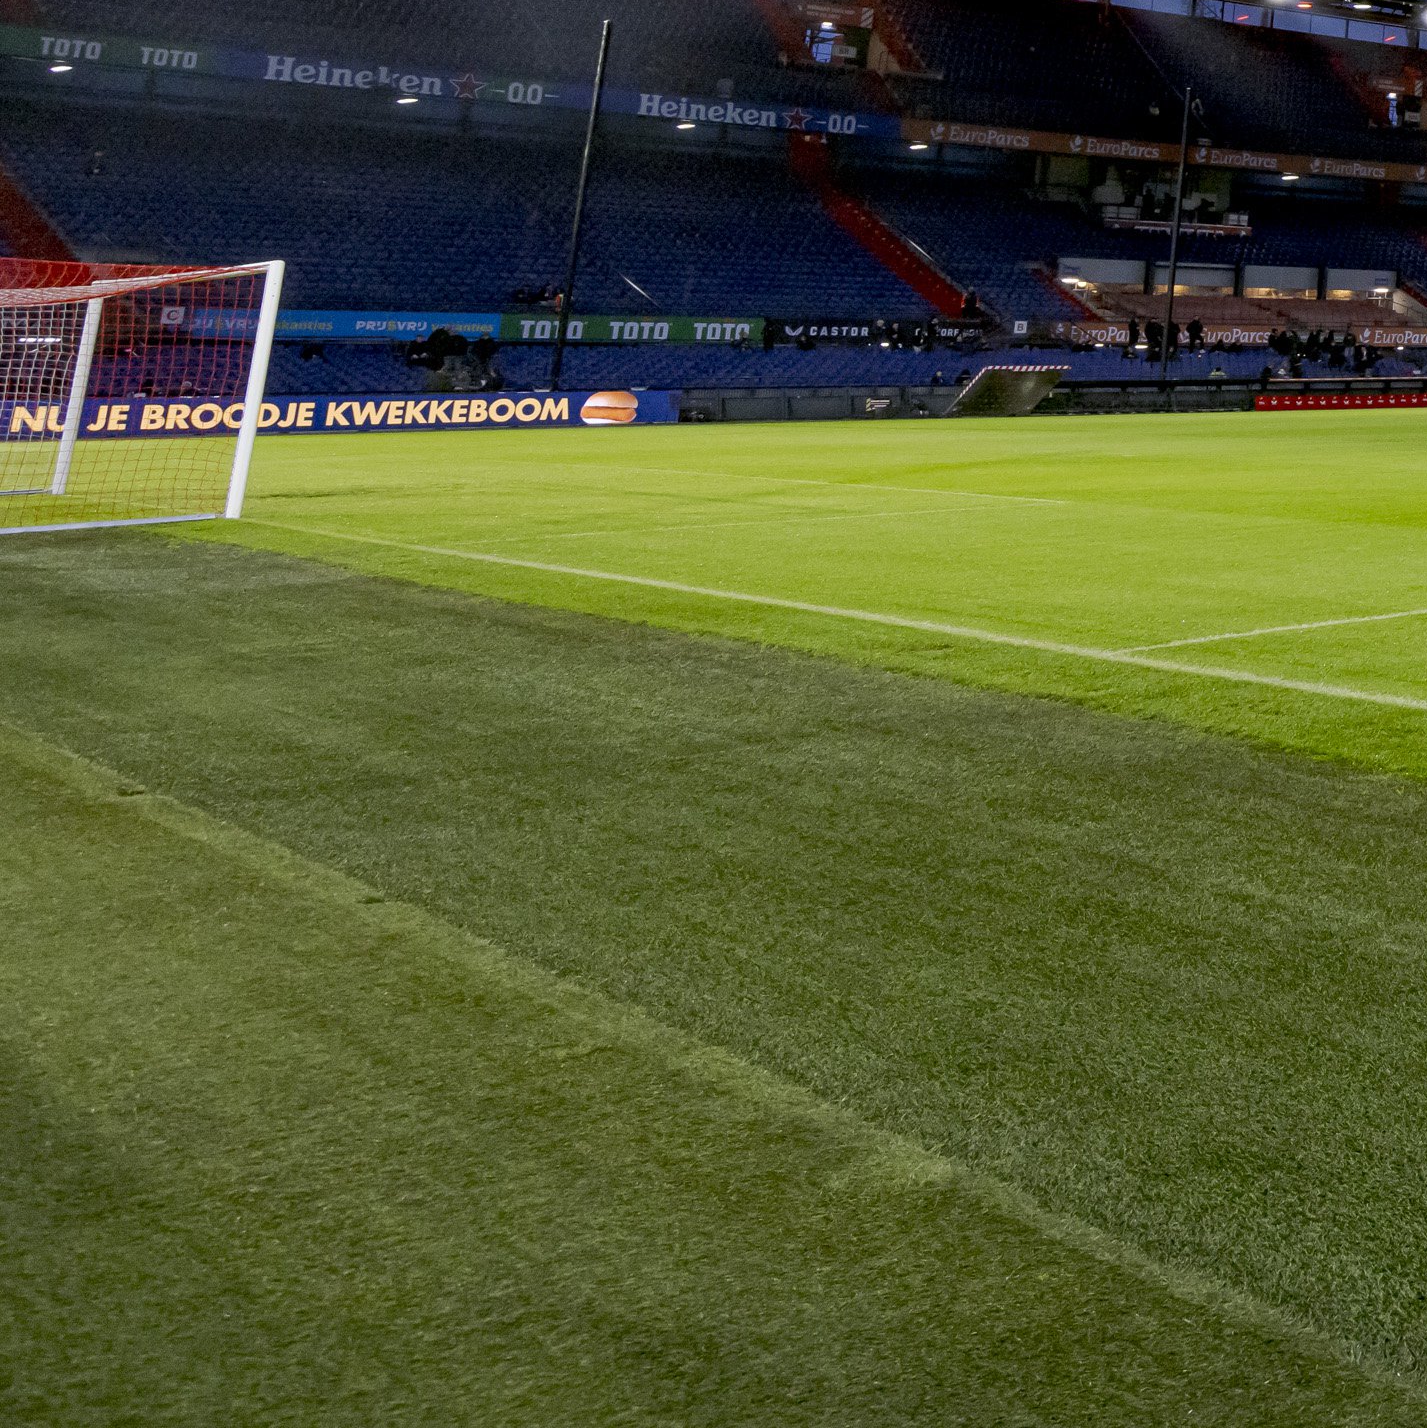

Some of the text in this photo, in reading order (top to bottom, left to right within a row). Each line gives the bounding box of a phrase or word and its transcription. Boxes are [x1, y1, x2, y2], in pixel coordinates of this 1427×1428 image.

[41, 36, 101, 60] TOTO
[140, 47, 198, 70] TOTO
[264, 55, 442, 97] Heineken
[637, 93, 777, 129] Heineken
[949, 126, 1030, 149] EuroParcs
[1085, 135, 1161, 160] EuroParcs
[1209, 152, 1278, 171] EuroParcs
[1323, 160, 1386, 179] EuroParcs
[609, 320, 671, 340] TOTO
[693, 321, 750, 340] TOTO
[10, 397, 570, 433] NU JE BROODJE KWEKKEBOOM
